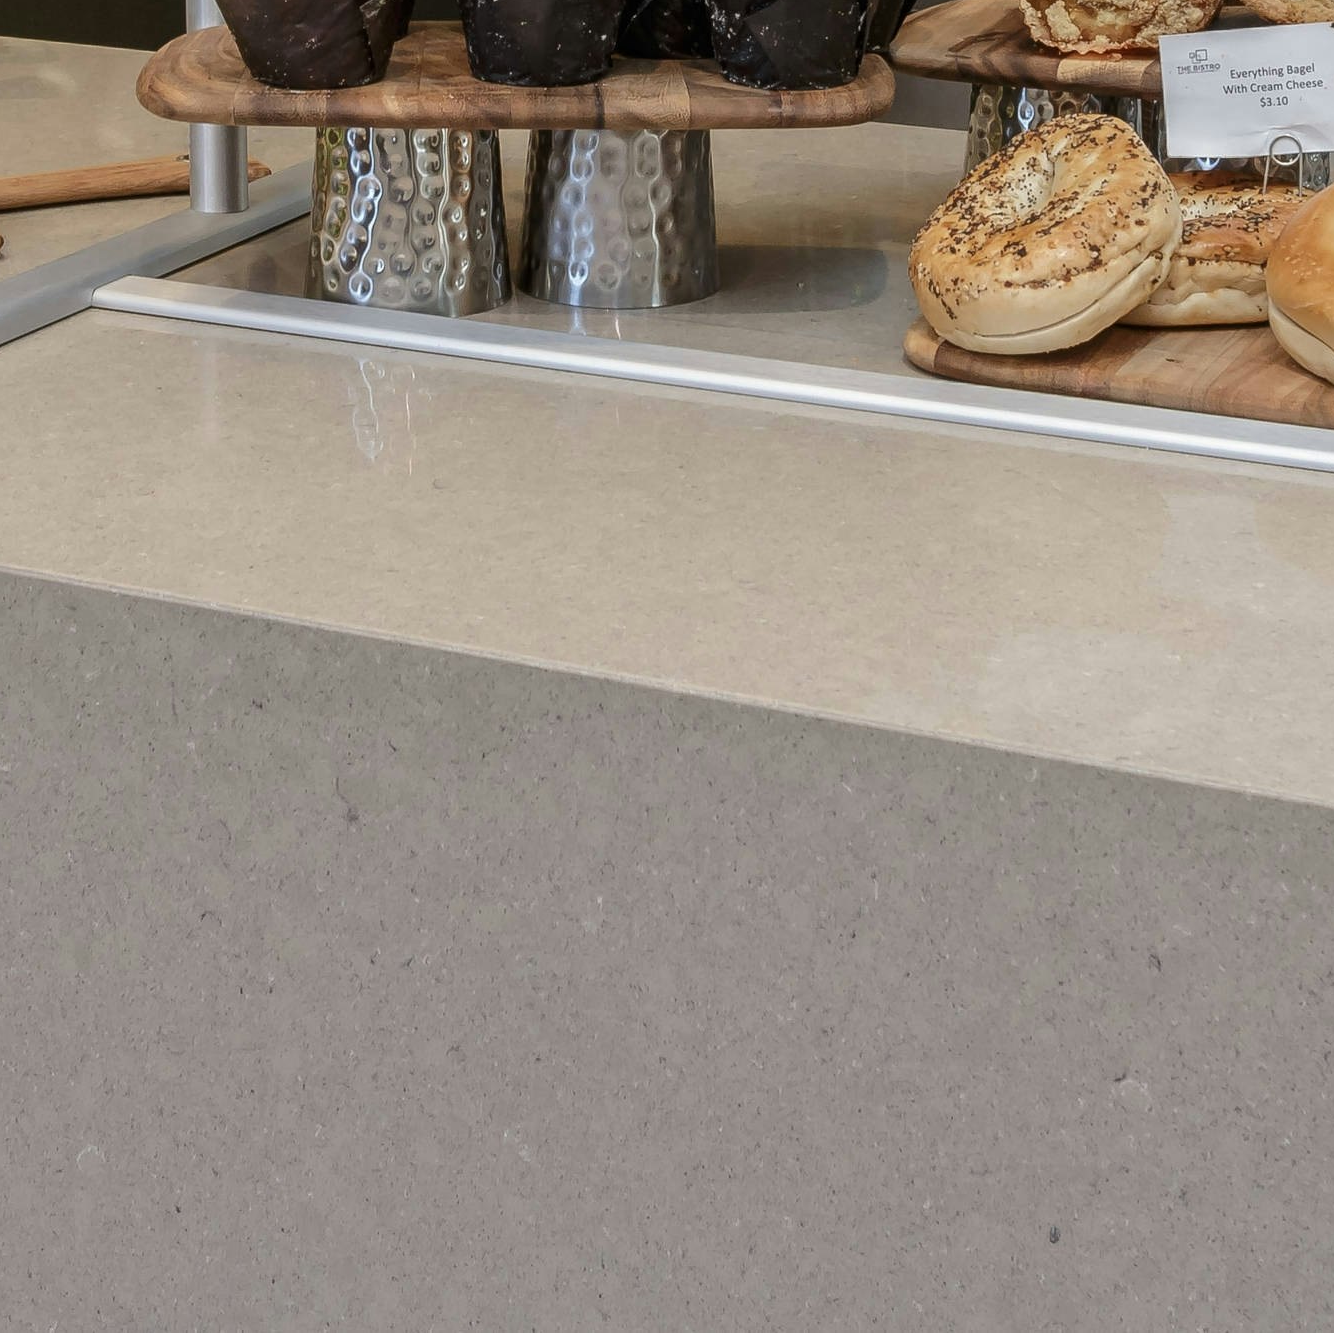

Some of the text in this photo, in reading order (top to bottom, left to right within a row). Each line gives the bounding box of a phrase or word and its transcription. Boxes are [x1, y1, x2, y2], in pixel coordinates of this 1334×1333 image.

[1177, 63, 1221, 73] THE BISTRO
[1230, 62, 1315, 79] Everything Bagel
[1222, 78, 1324, 95] With Cream Cheese
[1259, 96, 1289, 108] $3.10
